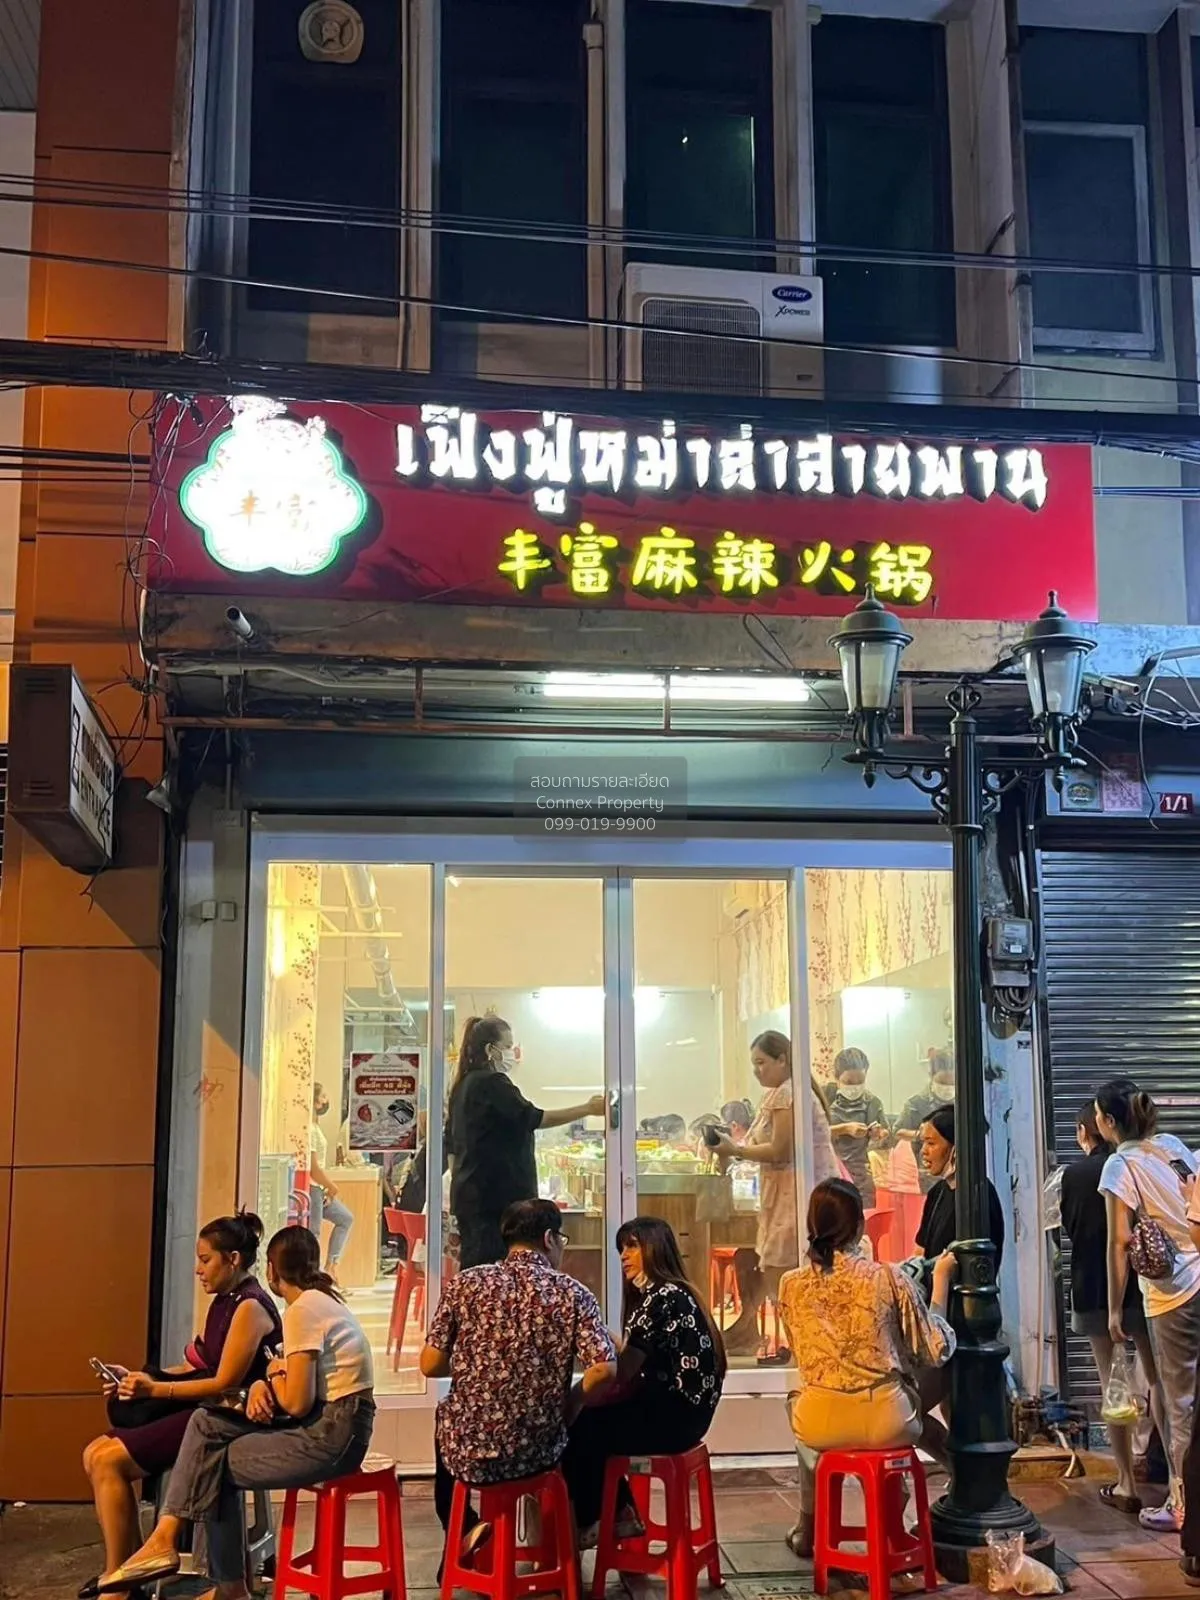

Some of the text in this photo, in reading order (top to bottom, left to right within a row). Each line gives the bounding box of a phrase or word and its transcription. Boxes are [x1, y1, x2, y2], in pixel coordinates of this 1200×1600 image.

[776, 288, 808, 299] Carrier
[498, 521, 933, 602] 丰富麻辣火锅
